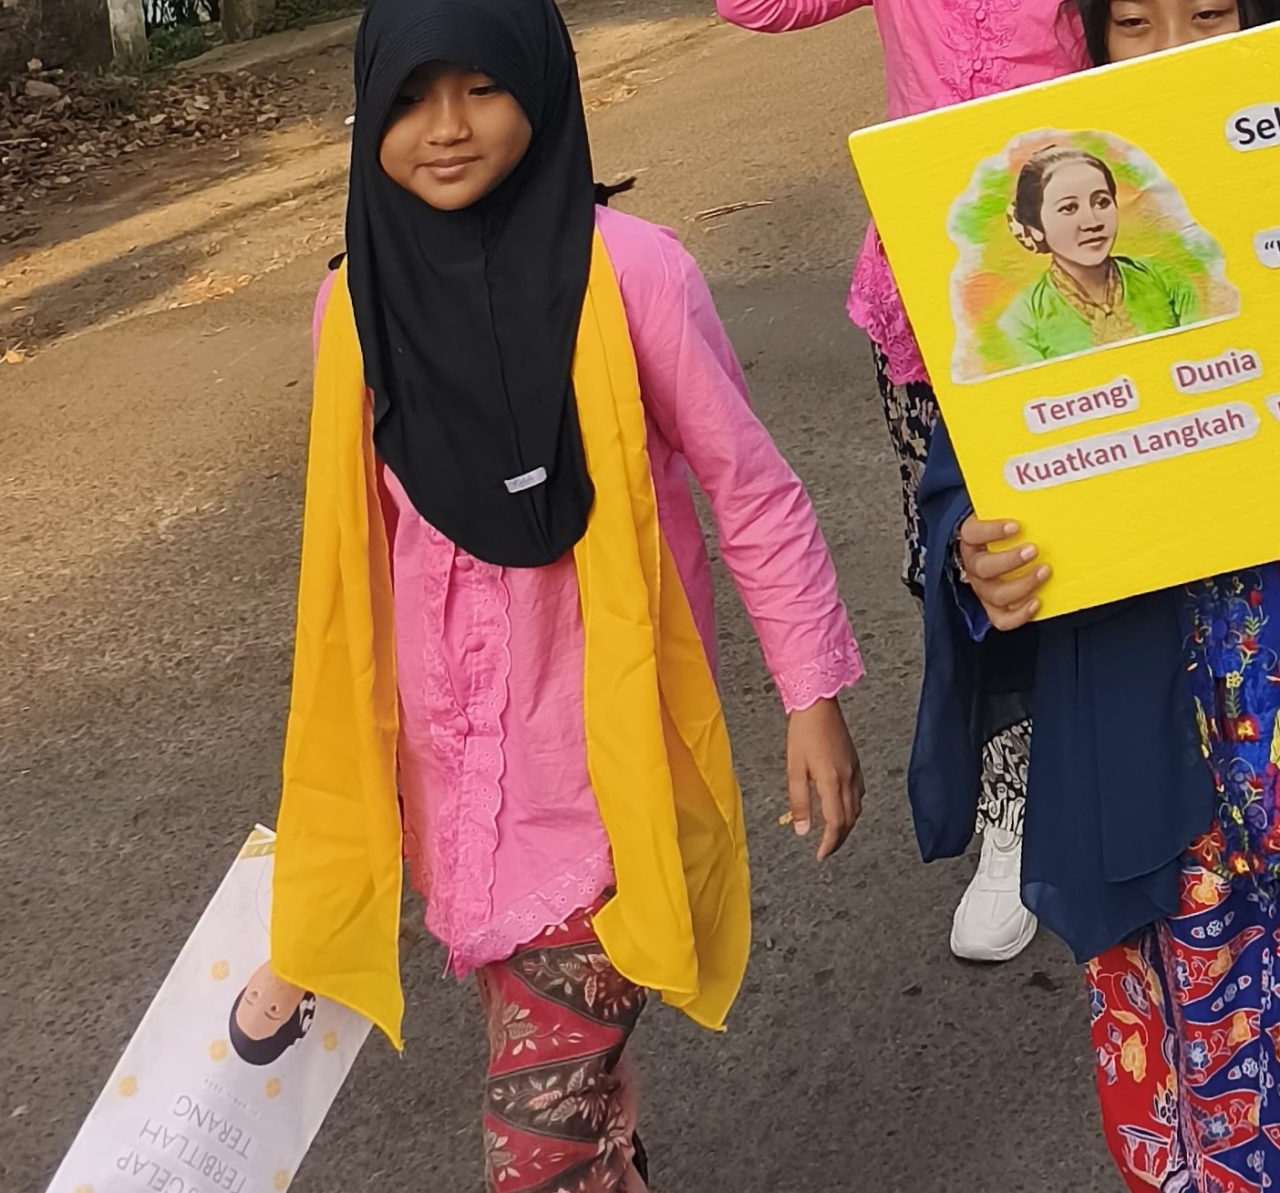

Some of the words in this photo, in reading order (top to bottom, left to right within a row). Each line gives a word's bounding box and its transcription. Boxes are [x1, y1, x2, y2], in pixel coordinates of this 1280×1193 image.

[1030, 378, 1135, 426] Terangi
[1174, 350, 1257, 388] Dunia
[1015, 440, 1127, 486] Kuatkan
[1132, 408, 1246, 458] Langkah
[138, 1118, 247, 1193] TERBITLAH
[172, 1094, 252, 1159] TERANG
